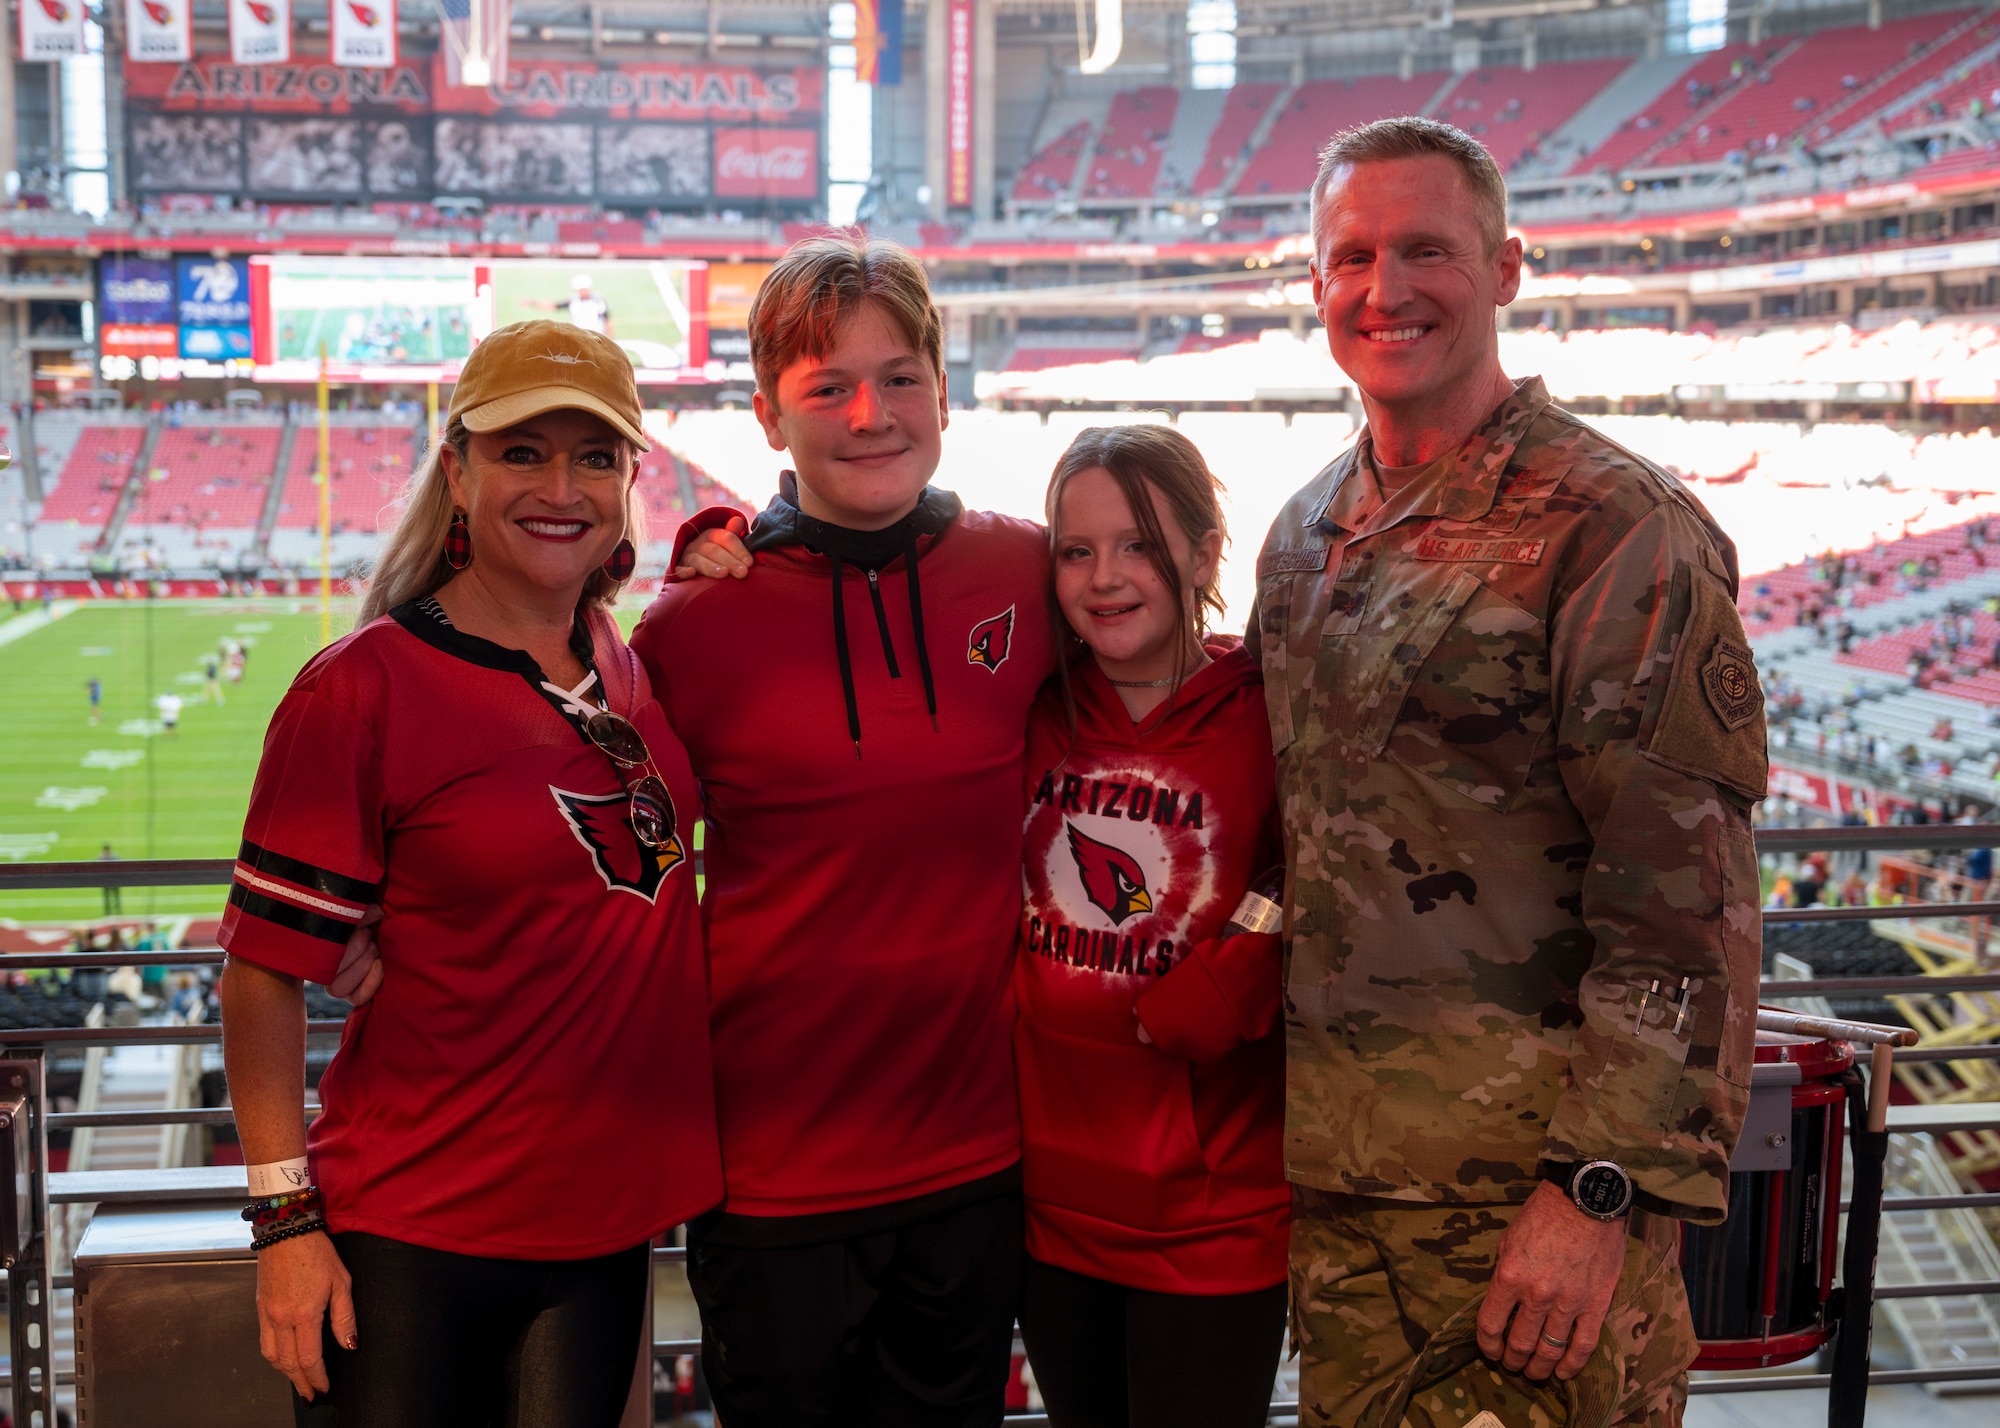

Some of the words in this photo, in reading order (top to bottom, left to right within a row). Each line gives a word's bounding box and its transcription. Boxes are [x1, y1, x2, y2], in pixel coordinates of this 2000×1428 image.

[168, 62, 428, 104] ARIZONA
[488, 68, 801, 112] CARDINALS
[1449, 541, 1482, 560] AIR
[1482, 541, 1542, 563] FORCE
[1034, 769, 1205, 831] ARIZONA
[1027, 915, 1175, 978] CARDINALS
